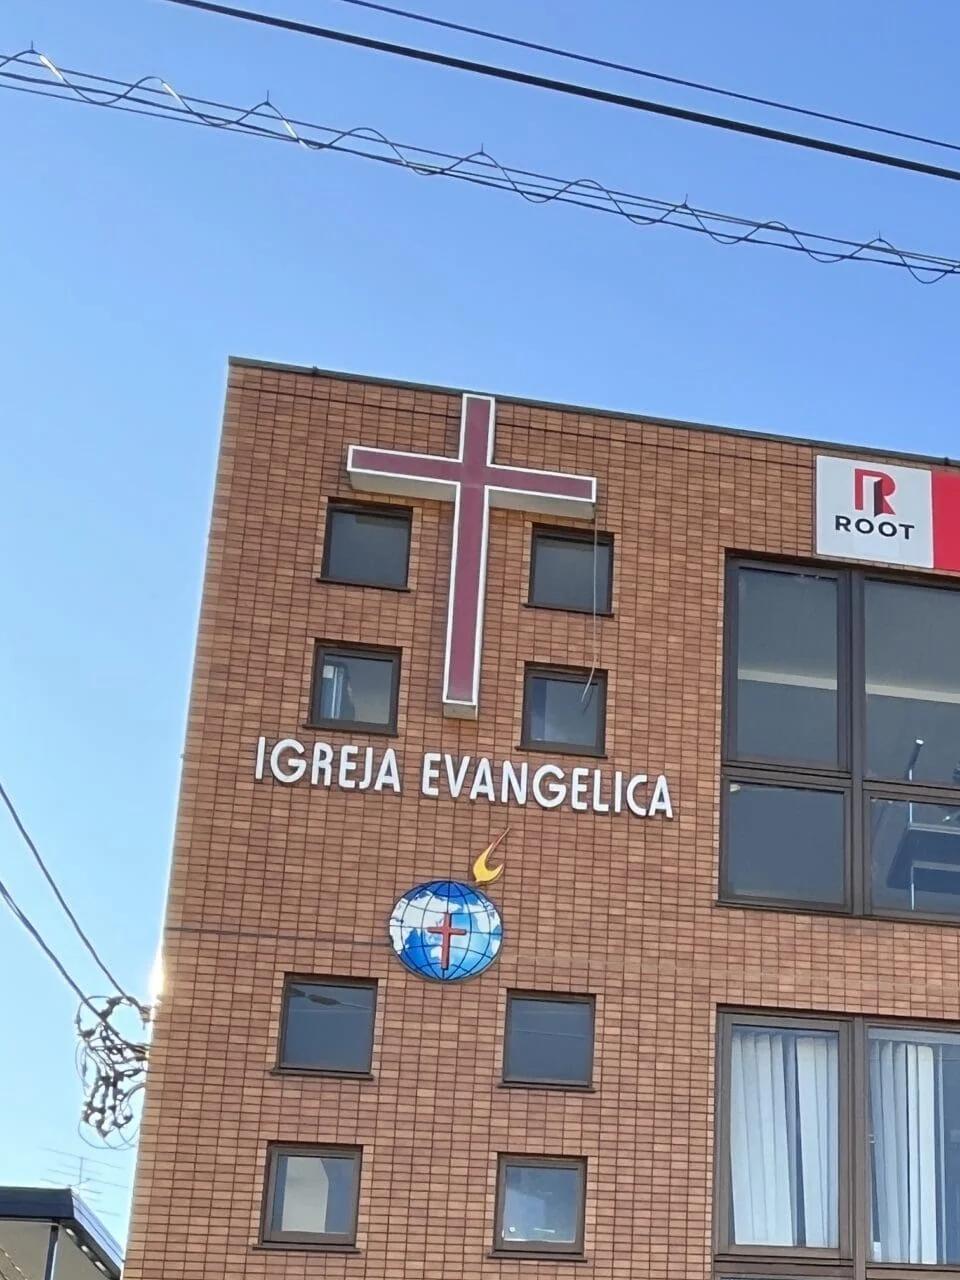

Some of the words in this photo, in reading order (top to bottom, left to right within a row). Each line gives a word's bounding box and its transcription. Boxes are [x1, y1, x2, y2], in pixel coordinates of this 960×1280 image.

[835, 515, 915, 540] ROOT
[254, 736, 401, 793] IGREJA
[422, 752, 674, 819] EVANGELICA
